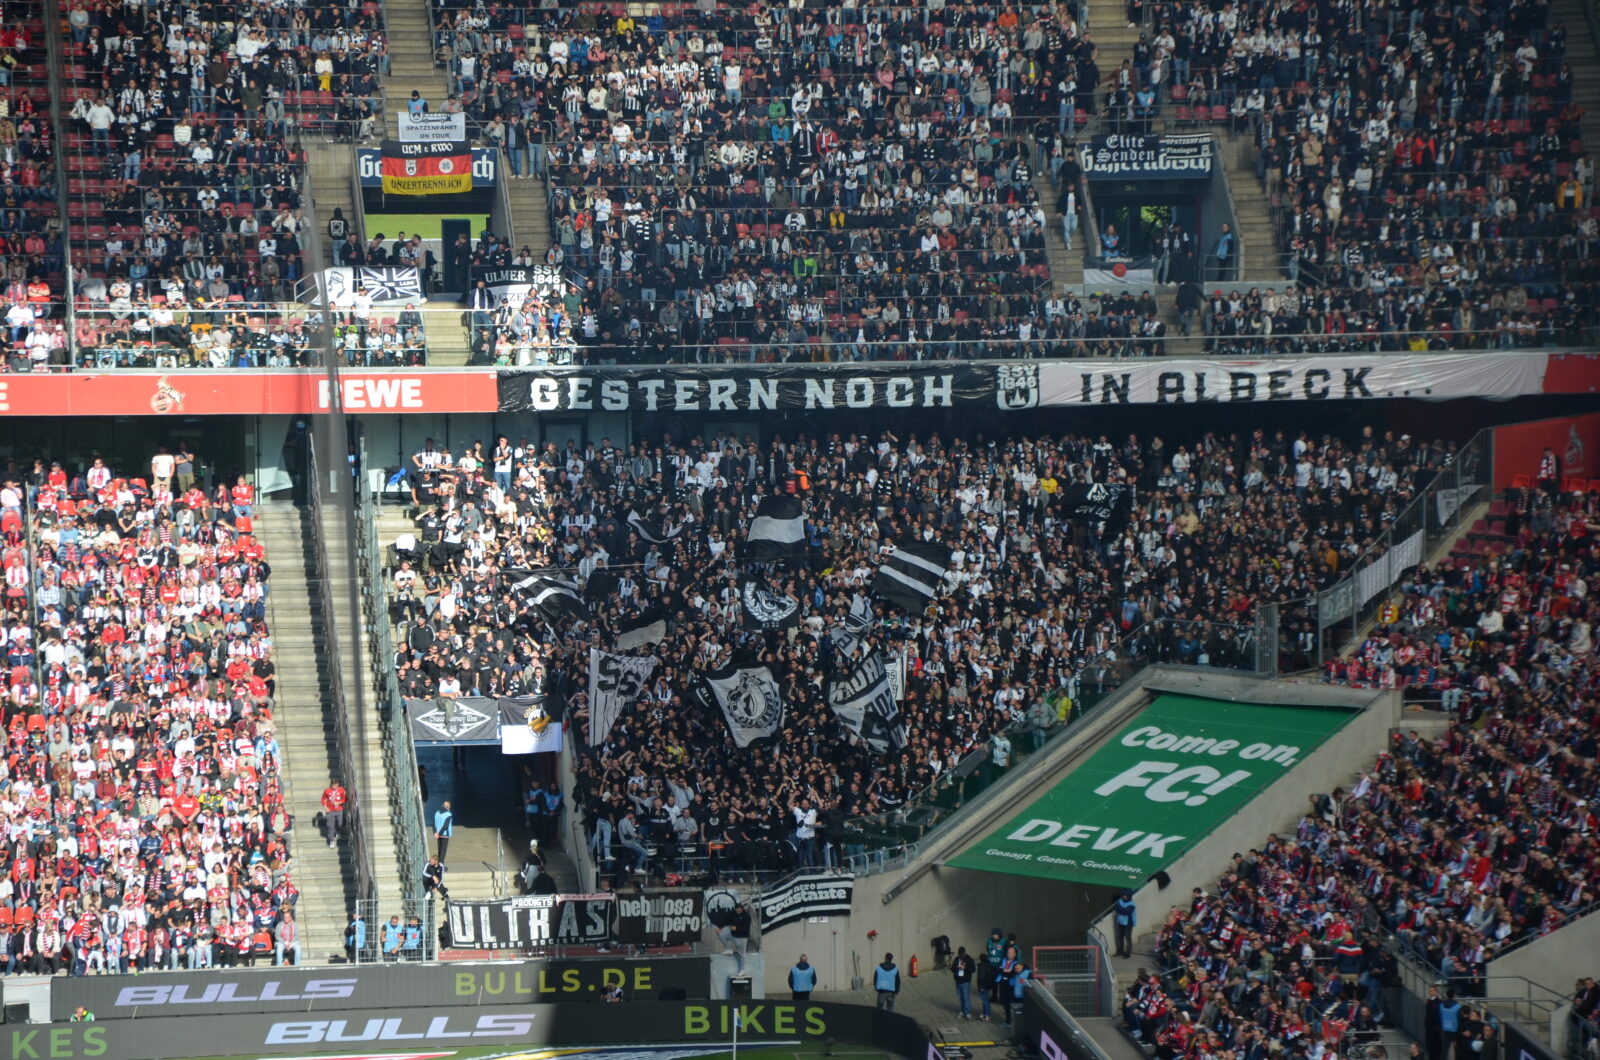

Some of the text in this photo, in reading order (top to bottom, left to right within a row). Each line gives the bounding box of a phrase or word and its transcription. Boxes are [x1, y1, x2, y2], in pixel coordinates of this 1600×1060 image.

[402, 144, 422, 155] ULM
[431, 143, 454, 153] RWO
[1106, 134, 1145, 149] Elite
[1096, 149, 1156, 163] Senden
[485, 270, 527, 283] ULMER
[533, 264, 562, 274] SSV
[533, 274, 561, 284] 1846
[998, 366, 1037, 378] SSV
[999, 376, 1037, 391] 1846
[530, 377, 780, 411] GESTERN
[804, 374, 954, 410] NOCH
[1080, 372, 1132, 403] IN
[1121, 725, 1300, 767] Come on,
[1094, 761, 1253, 807] FC!
[1006, 819, 1187, 859] DEVK
[986, 848, 1143, 875] Gesagt. Getan. Geholfen.
[513, 899, 553, 908] PRODIGYS
[620, 895, 694, 917] nebulosa
[766, 888, 848, 917] constante
[451, 901, 605, 943] ULTRAS
[646, 915, 699, 942] impero
[115, 979, 358, 1007] BULLS
[455, 967, 652, 996] BULLS.DE
[264, 1013, 536, 1045] BULLS
[685, 1006, 827, 1036] BIKES
[12, 1026, 107, 1060] KES
